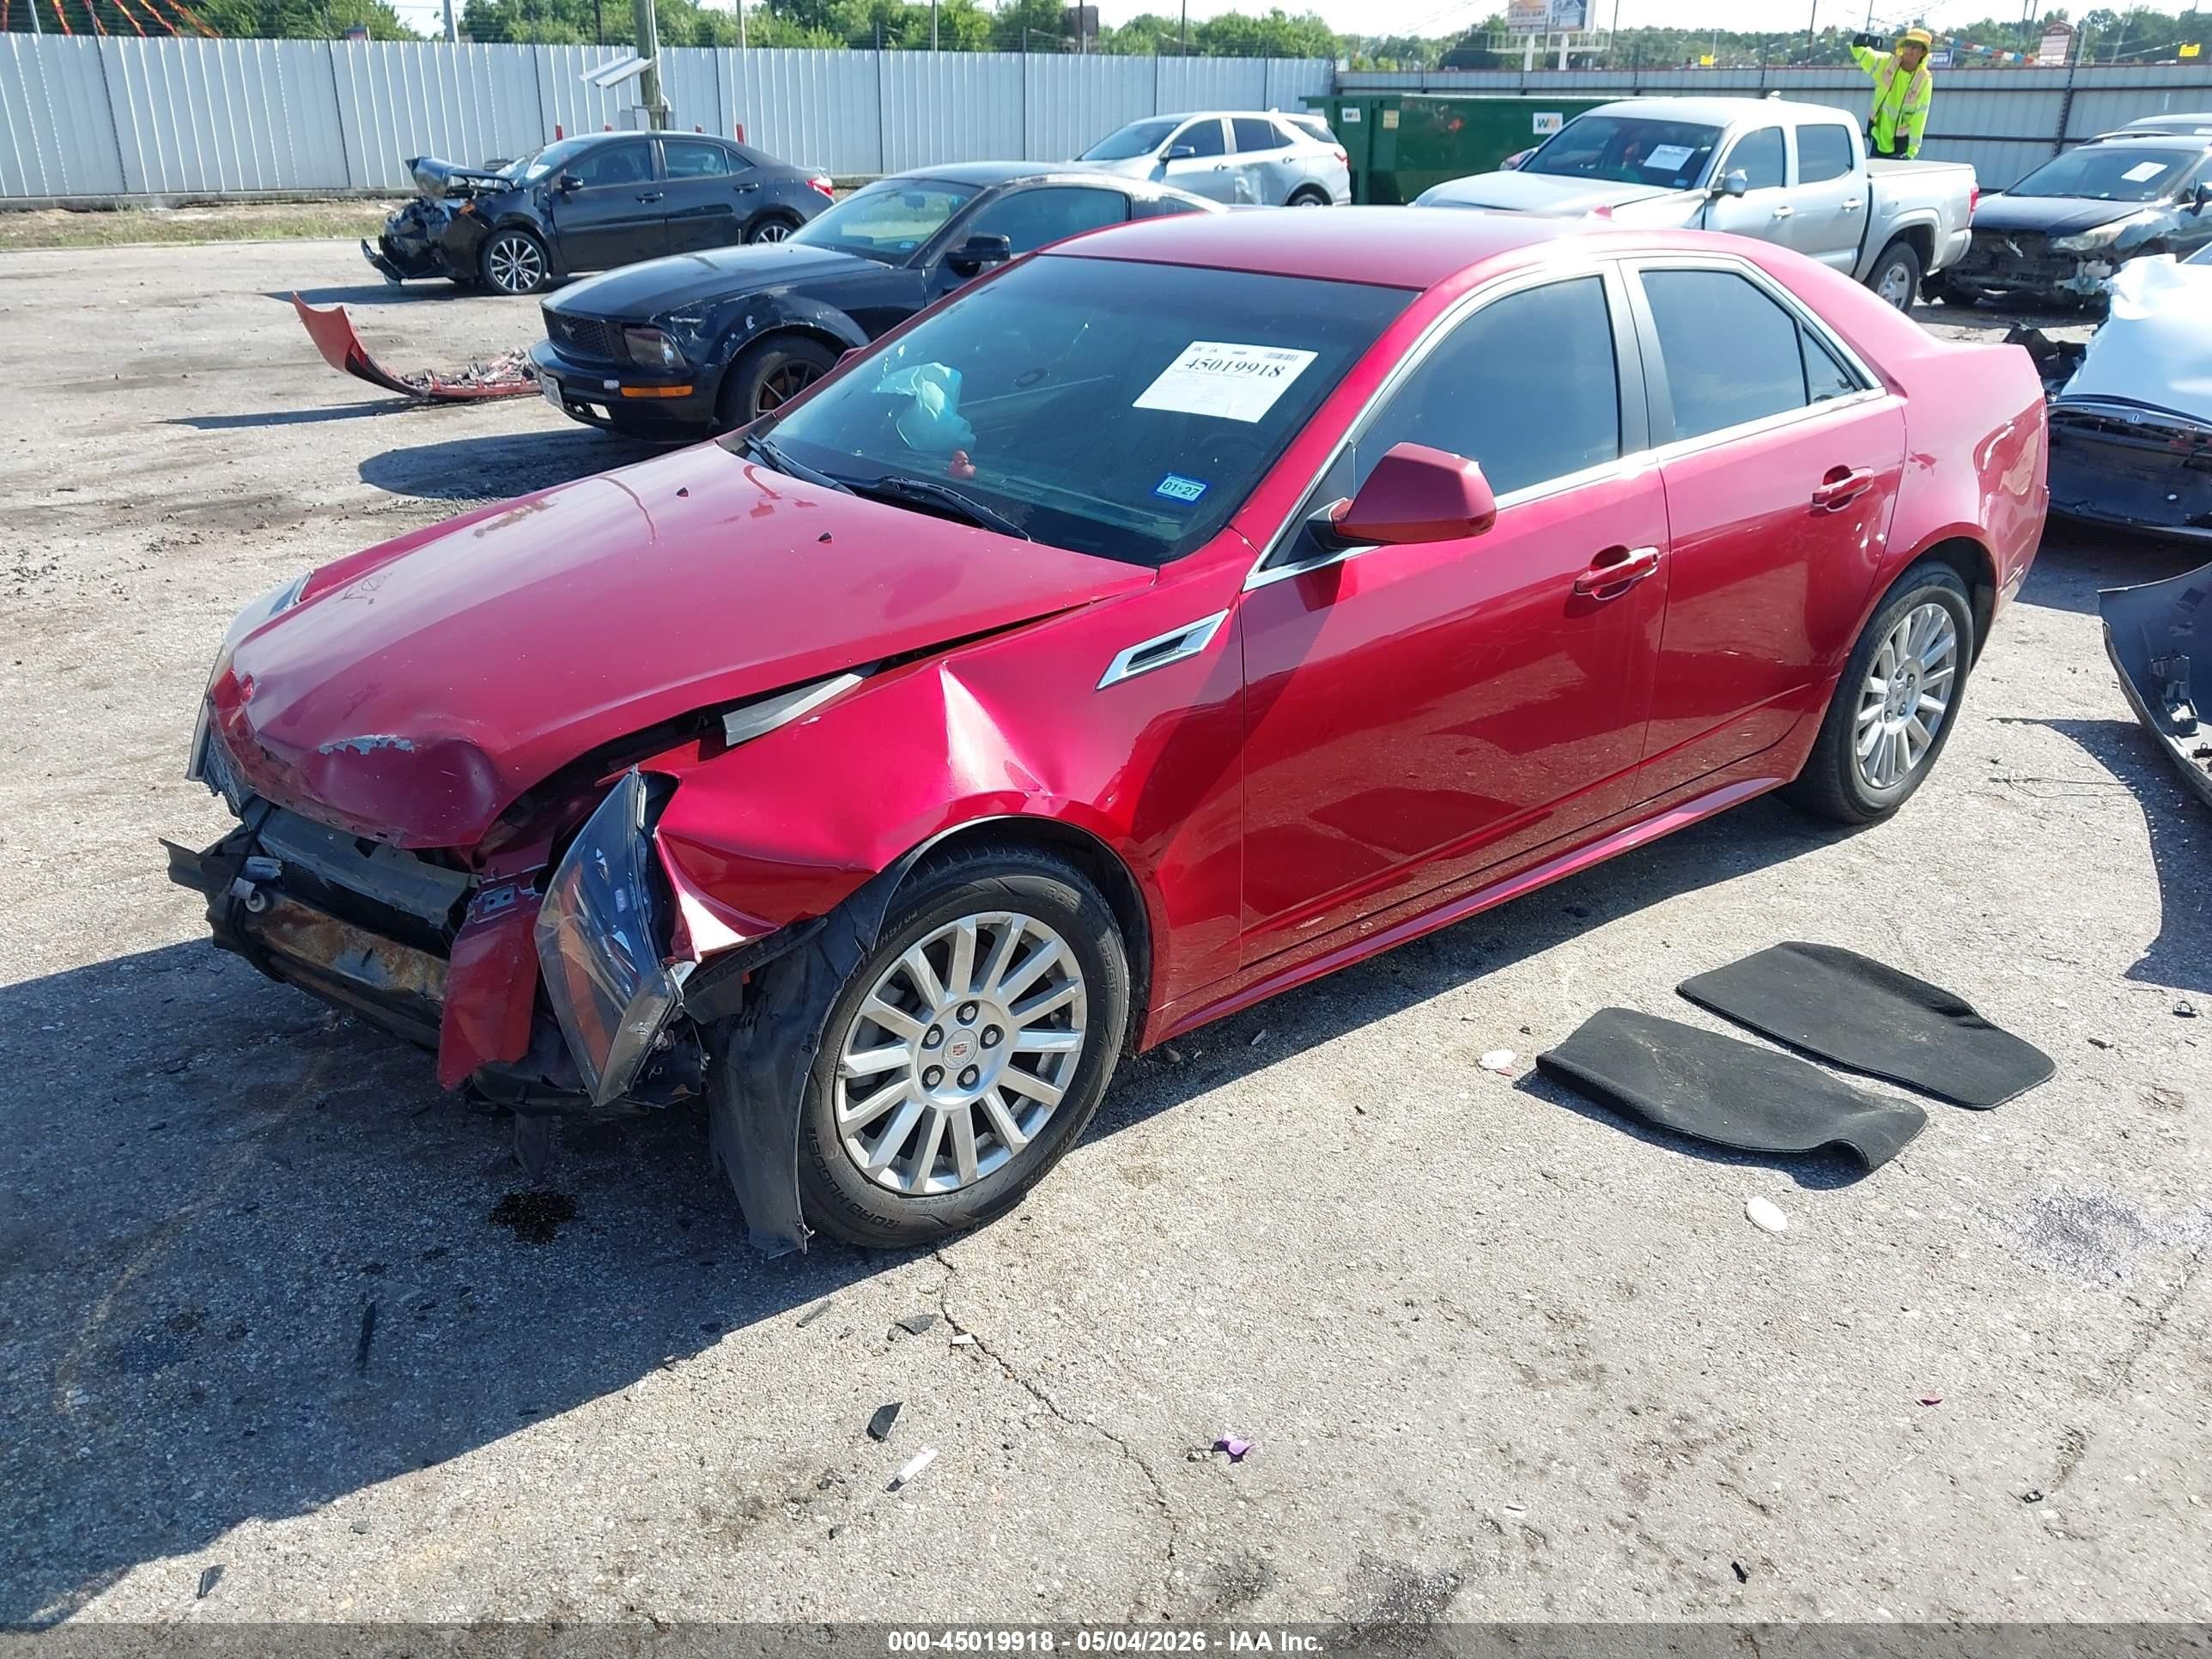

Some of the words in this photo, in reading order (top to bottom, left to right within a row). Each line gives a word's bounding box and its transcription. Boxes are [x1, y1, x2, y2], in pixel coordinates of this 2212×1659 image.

[1537, 118, 1559, 128] WM
[1184, 357, 1286, 378] 45019918
[806, 1127, 850, 1204] HUGGER
[848, 1202, 901, 1229] ROAD
